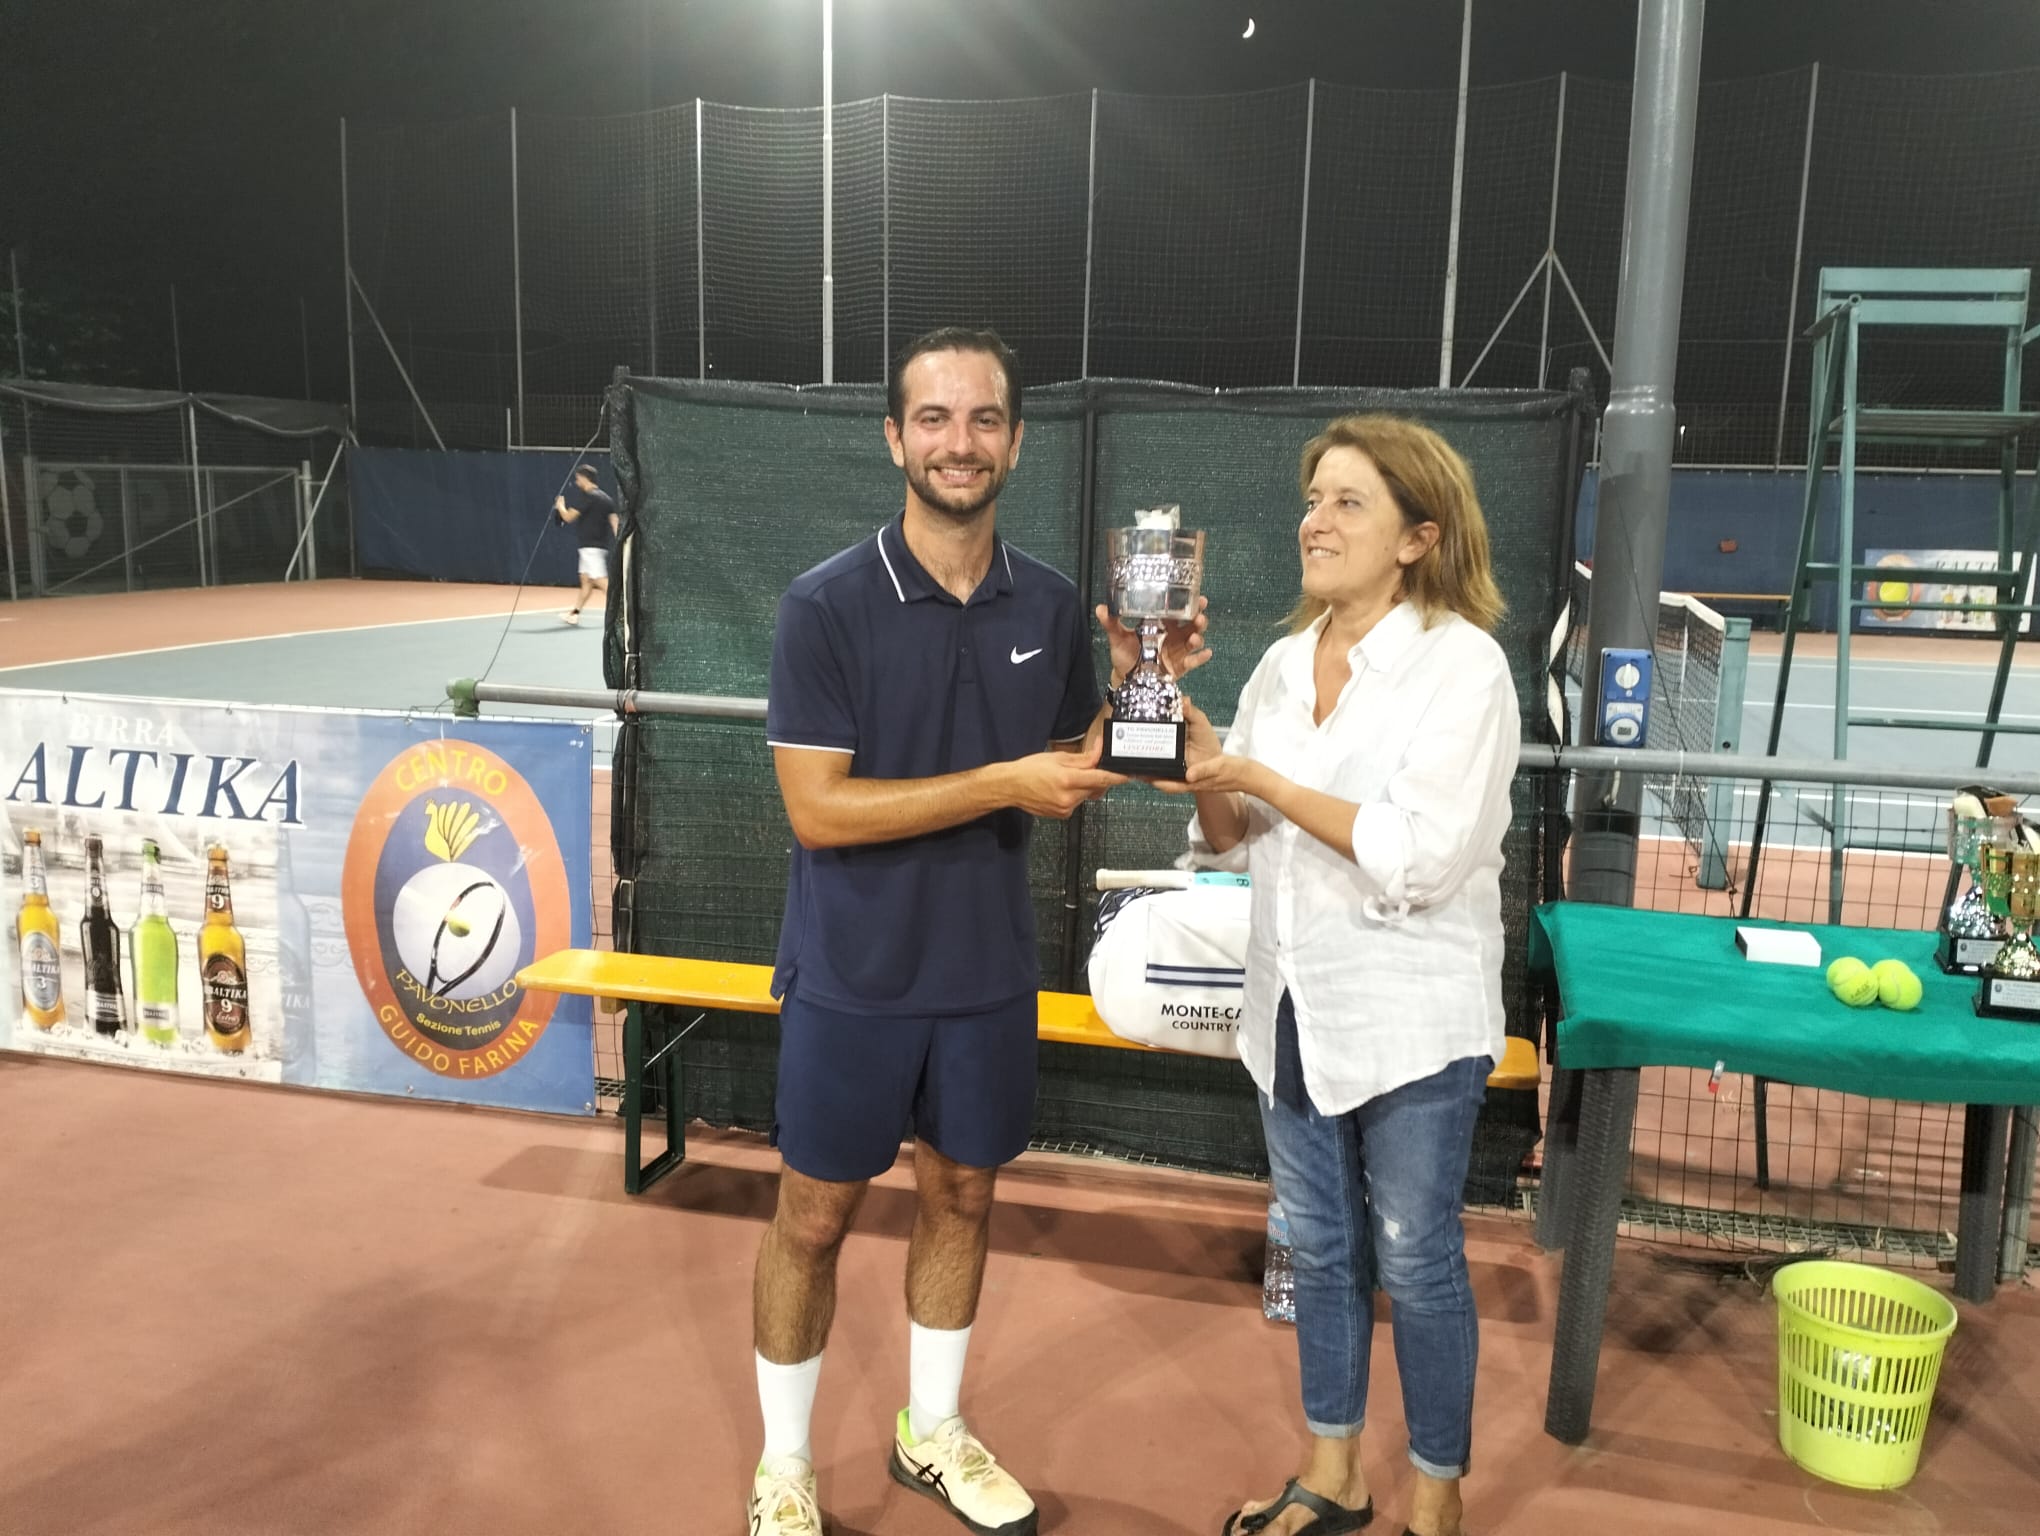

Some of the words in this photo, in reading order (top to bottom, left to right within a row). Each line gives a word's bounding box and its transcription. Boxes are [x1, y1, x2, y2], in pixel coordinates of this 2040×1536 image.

[69, 712, 175, 747] BIRRA
[5, 741, 303, 824] ALTIKA
[396, 749, 507, 796] CENTRO
[211, 893, 225, 909] 9
[37, 976, 47, 990] 3
[396, 968, 518, 1014] PAVONELLO
[220, 998, 233, 1013] 9
[416, 1013, 463, 1036] Sezione
[465, 1020, 502, 1036] Tennis
[1172, 1020, 1232, 1032] COUNTRY
[380, 1004, 450, 1071] GUIDO
[459, 1019, 539, 1075] FARINA
